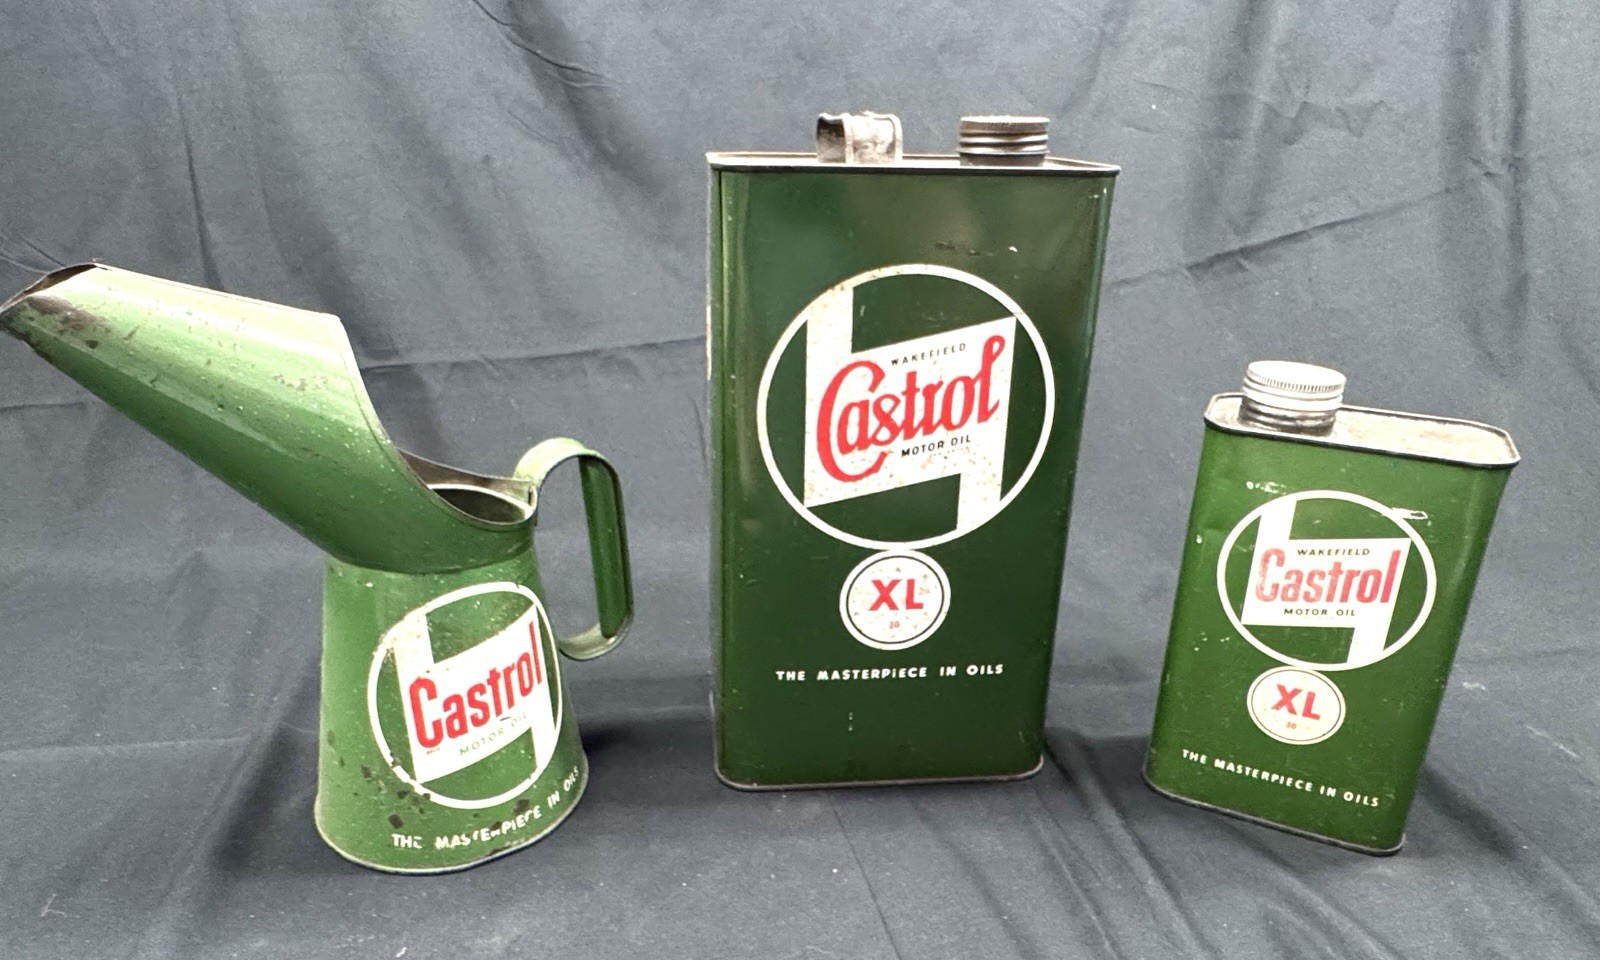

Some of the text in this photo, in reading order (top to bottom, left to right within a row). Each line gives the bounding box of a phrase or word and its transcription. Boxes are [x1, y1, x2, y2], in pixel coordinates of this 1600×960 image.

[891, 343, 966, 366] WAKEFIELD
[817, 335, 1006, 482] Castrol
[901, 441, 945, 457] MOTOR
[950, 435, 971, 446] OIL
[1297, 548, 1370, 556] WAKEFIELD
[1255, 548, 1402, 604] Castrol
[868, 578, 924, 612] XL
[1284, 608, 1355, 616] MOTOR OIL
[409, 620, 542, 749] Castrol
[775, 664, 1004, 681] THE MASTERPIECE IN OILS
[1271, 683, 1321, 721] XL
[459, 727, 505, 756] MOTOR
[1182, 749, 1379, 807] THE MASTERPIECE IN OILS
[391, 833, 423, 849] THE
[547, 790, 560, 809] IN
